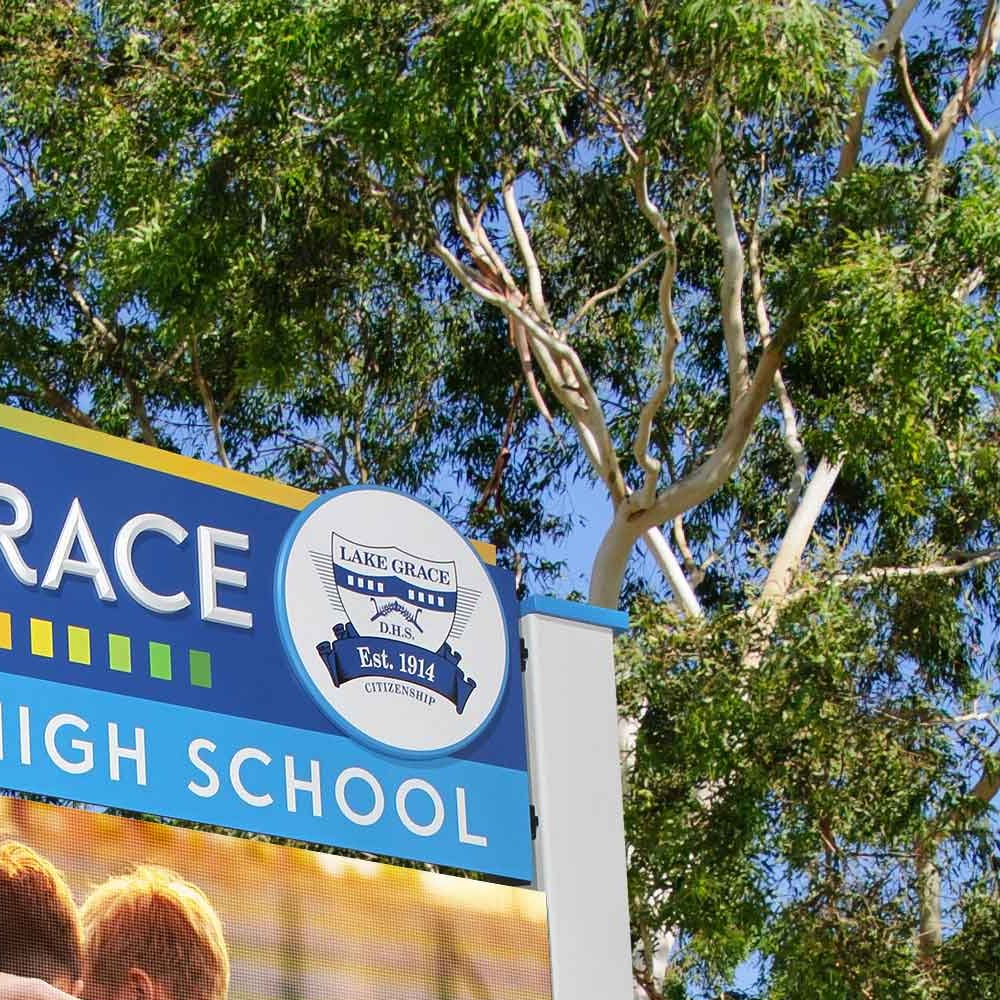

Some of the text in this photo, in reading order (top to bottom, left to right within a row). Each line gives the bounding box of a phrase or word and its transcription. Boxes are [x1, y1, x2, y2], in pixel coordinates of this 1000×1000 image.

[340, 546, 450, 586] LAKE GRACE
[379, 621, 416, 641] D.H.S.
[356, 646, 436, 683] Est. 1914
[364, 682, 436, 706] CITIZENSHIP
[187, 738, 488, 848] SCHOOL
